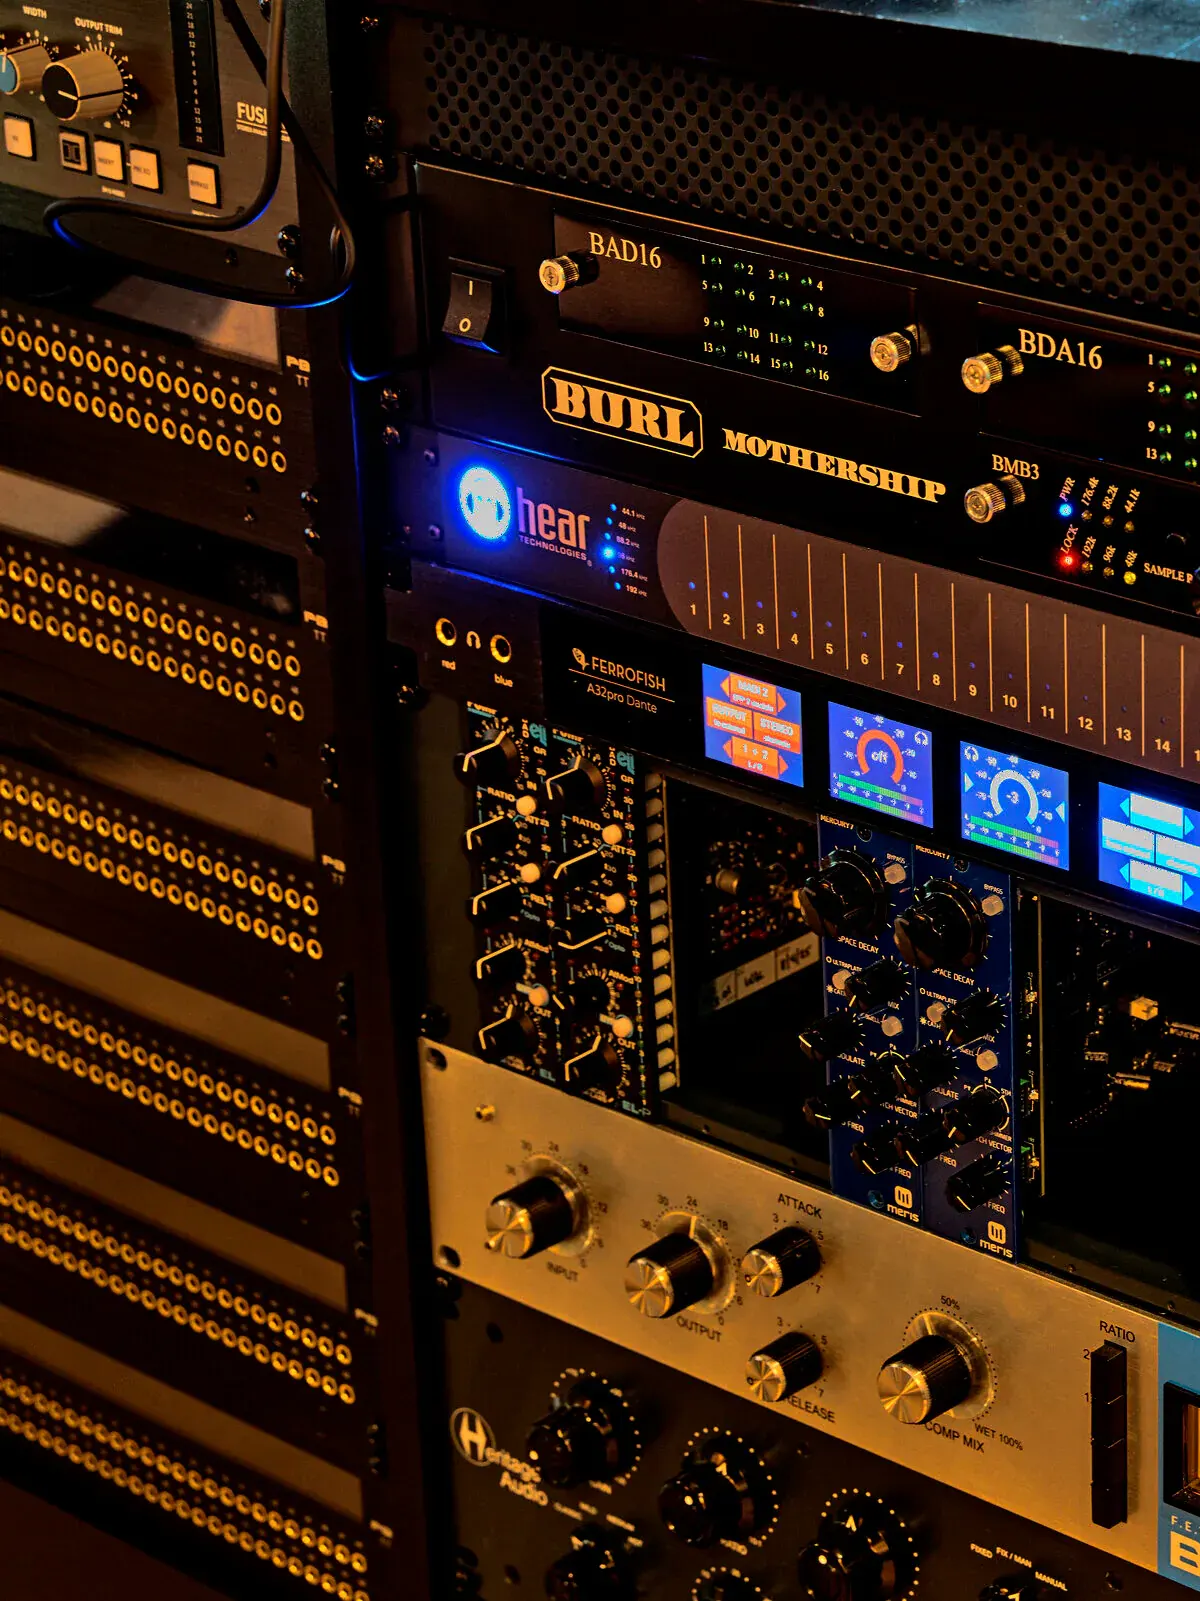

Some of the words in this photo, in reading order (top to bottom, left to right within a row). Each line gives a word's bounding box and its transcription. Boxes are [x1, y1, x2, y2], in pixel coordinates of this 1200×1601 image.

[588, 232, 661, 268] BAD16
[702, 255, 705, 264] 1
[748, 265, 753, 275] 2
[769, 270, 774, 279] 3
[817, 281, 823, 290] 4
[703, 280, 707, 289] 5
[749, 292, 754, 301] 6
[770, 296, 775, 305] 7
[819, 307, 824, 317] 8
[704, 317, 709, 326] 9
[749, 328, 759, 338] 10
[770, 333, 778, 343] 11
[818, 344, 828, 355] 12
[1017, 329, 1102, 370] BDA16
[704, 342, 713, 352] 13
[750, 353, 760, 364] 14
[772, 358, 780, 368] 15
[819, 370, 829, 380] 16
[1149, 354, 1153, 365] 1
[1148, 382, 1154, 392] 5
[550, 376, 694, 449] BURL
[1148, 421, 1155, 431] 9
[722, 428, 946, 503] MOTHERSHIP
[1147, 448, 1157, 459] 13
[992, 454, 1039, 481] BMB3
[1059, 477, 1075, 501] PWR
[1081, 477, 1099, 505] 176.4k
[1103, 485, 1118, 509] 88.2k
[1125, 489, 1140, 513] 44.1k
[516, 487, 590, 550] hear
[519, 534, 587, 561] TECHNOLOGIES
[1060, 524, 1080, 555] LOCK
[1081, 536, 1096, 559] 192k
[1103, 546, 1116, 562] 96k
[1125, 551, 1137, 567] 48k
[1144, 563, 1184, 581] SAMPLE
[442, 660, 455, 670] red
[591, 657, 665, 692] FERROFISH
[691, 604, 695, 615] 1
[723, 614, 730, 625] 2
[757, 624, 764, 634] 3
[791, 634, 798, 644] 4
[826, 643, 833, 654] 5
[861, 654, 868, 664] 6
[897, 664, 904, 674] 7
[933, 674, 940, 685] 8
[969, 685, 976, 696] 9
[1003, 695, 1017, 708] 10
[1041, 706, 1054, 719] 11
[1078, 717, 1092, 730] 12
[1116, 728, 1131, 741] 13
[1155, 739, 1170, 752] 14
[494, 674, 513, 687] blue
[587, 682, 625, 702] A32pro
[627, 694, 658, 713] Dante
[858, 941, 878, 953] DECAY
[954, 970, 974, 985] DECAY
[773, 1213, 779, 1223] 3
[777, 1192, 823, 1220] ATTACK
[886, 1203, 919, 1223] meris
[817, 1231, 824, 1241] 5
[979, 1238, 1012, 1259] meris
[547, 1262, 578, 1280] INPUT
[941, 1296, 960, 1311] 50%
[675, 1315, 723, 1341] OUTPUT
[1100, 1321, 1135, 1343] RATIO
[925, 1421, 960, 1442] COMP
[963, 1434, 986, 1453] MIX
[974, 1423, 996, 1440] WET
[999, 1434, 1023, 1450] 100%
